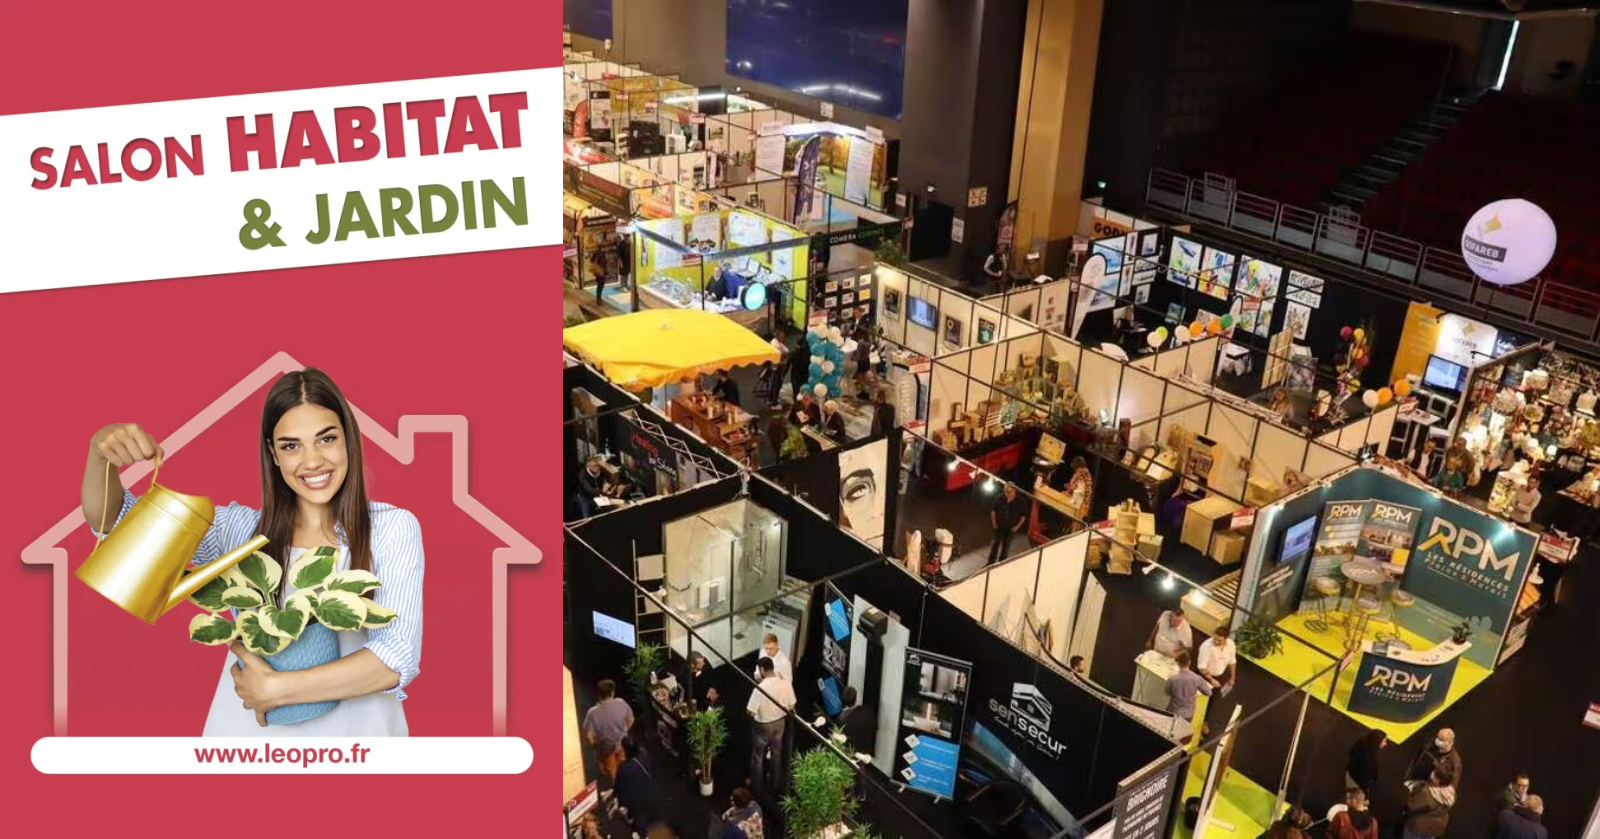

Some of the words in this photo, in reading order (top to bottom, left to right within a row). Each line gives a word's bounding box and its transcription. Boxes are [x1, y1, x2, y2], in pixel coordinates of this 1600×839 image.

[29, 134, 205, 191] SALON
[226, 91, 529, 173] HABITAT
[238, 199, 288, 251] &
[305, 176, 529, 245] JARDIN
[1327, 504, 1363, 520] RPM
[1370, 503, 1413, 524] RPM
[1416, 516, 1520, 582] RPM
[1426, 551, 1446, 563] LES
[1450, 561, 1510, 592] RÉSIDENCES
[1363, 664, 1433, 692] RPM
[989, 698, 1067, 755] sensecur
[193, 743, 371, 768] www.leopro.fr
